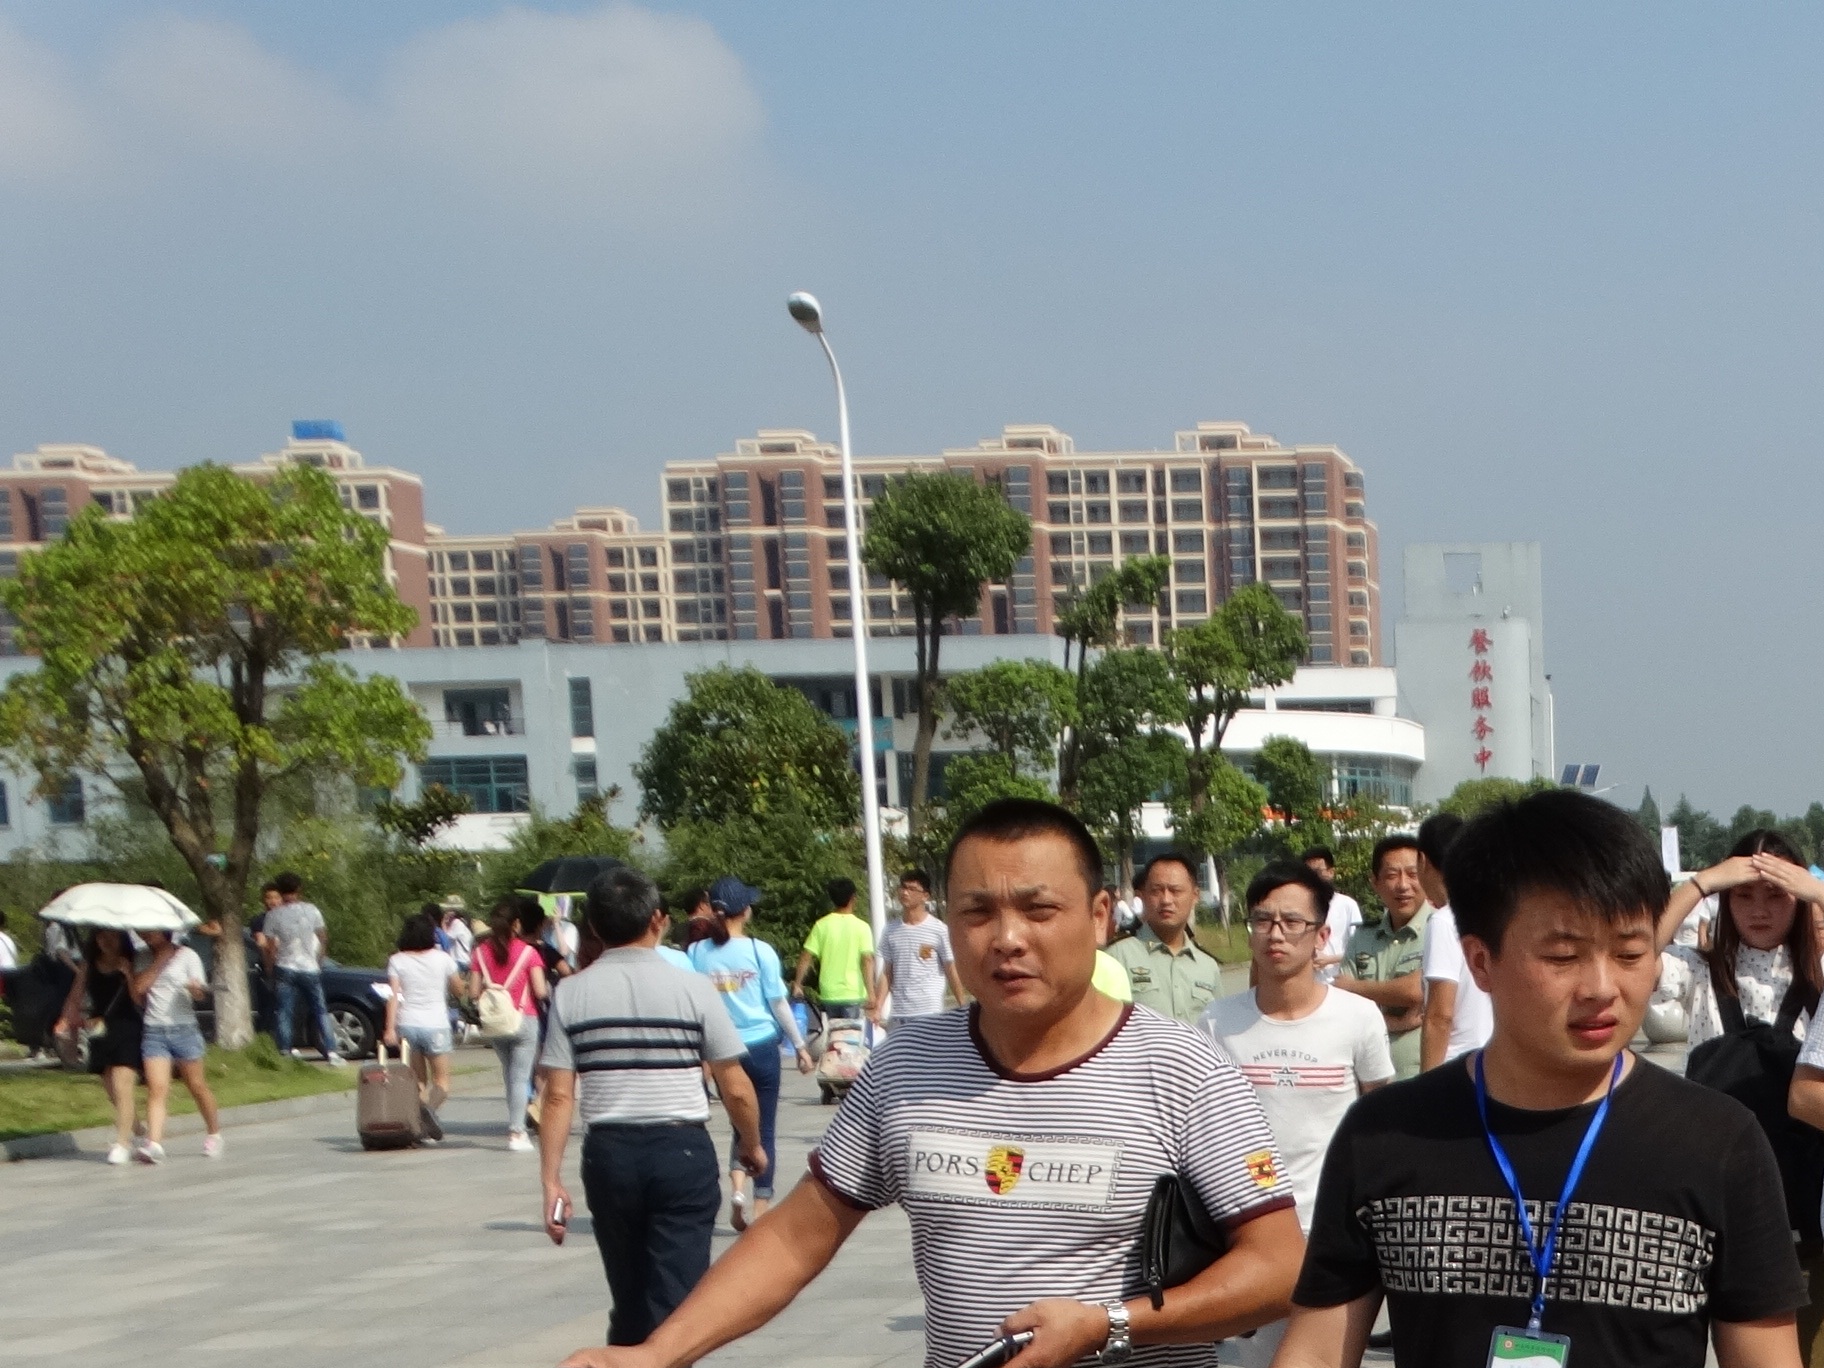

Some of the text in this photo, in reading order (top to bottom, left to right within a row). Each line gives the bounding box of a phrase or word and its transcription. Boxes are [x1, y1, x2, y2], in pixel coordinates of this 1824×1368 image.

[1252, 1048, 1319, 1063] NEVER STOP
[914, 1150, 1103, 1185] PORS CHEP
